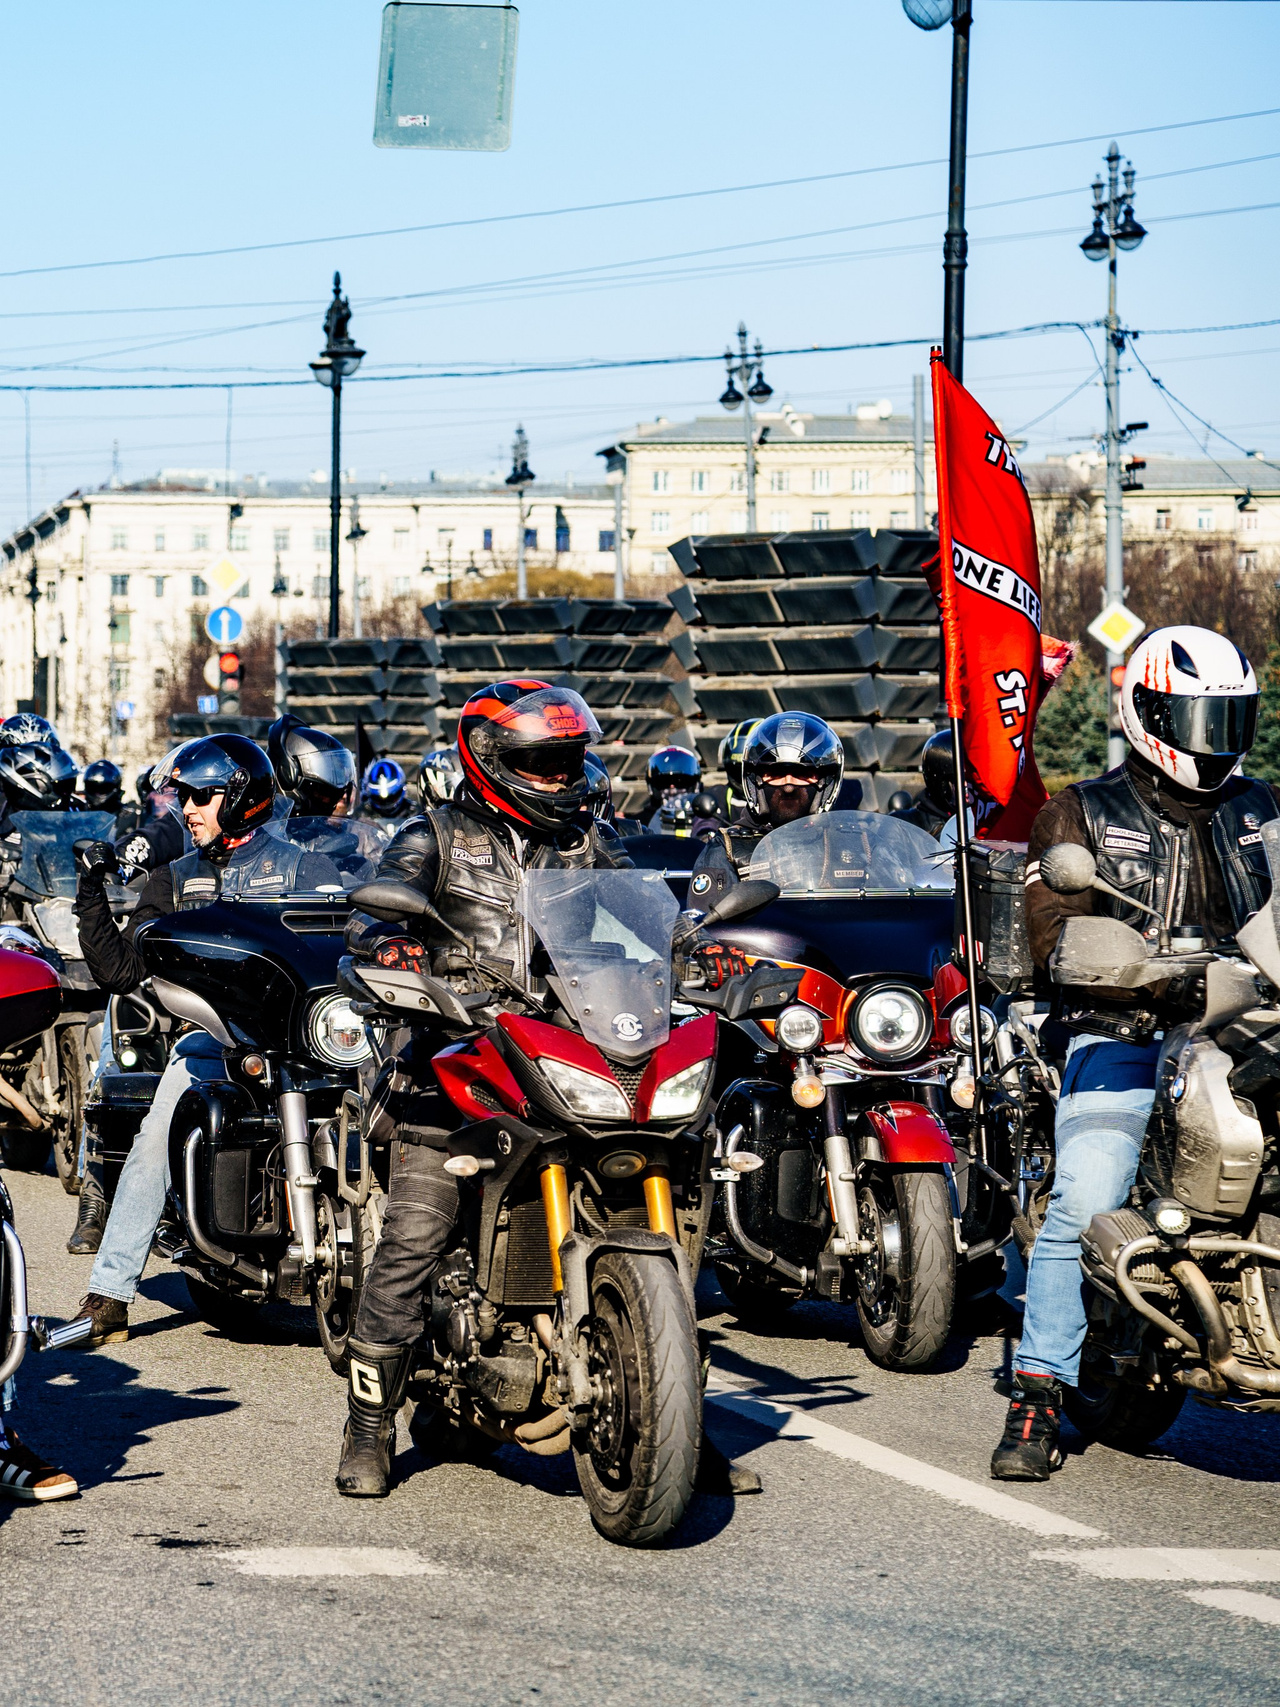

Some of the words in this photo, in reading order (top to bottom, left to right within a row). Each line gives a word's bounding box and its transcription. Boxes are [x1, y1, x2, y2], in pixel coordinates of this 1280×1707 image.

[952, 547, 1005, 594] ONE
[1010, 578, 1042, 622] LIFE
[1204, 683, 1245, 692] LS2
[549, 717, 578, 731] SHOEI
[1107, 827, 1150, 841] HOOLIGANS
[1242, 833, 1262, 844] MEM
[836, 870, 864, 878] MEMBER
[251, 876, 282, 887] MEMBER
